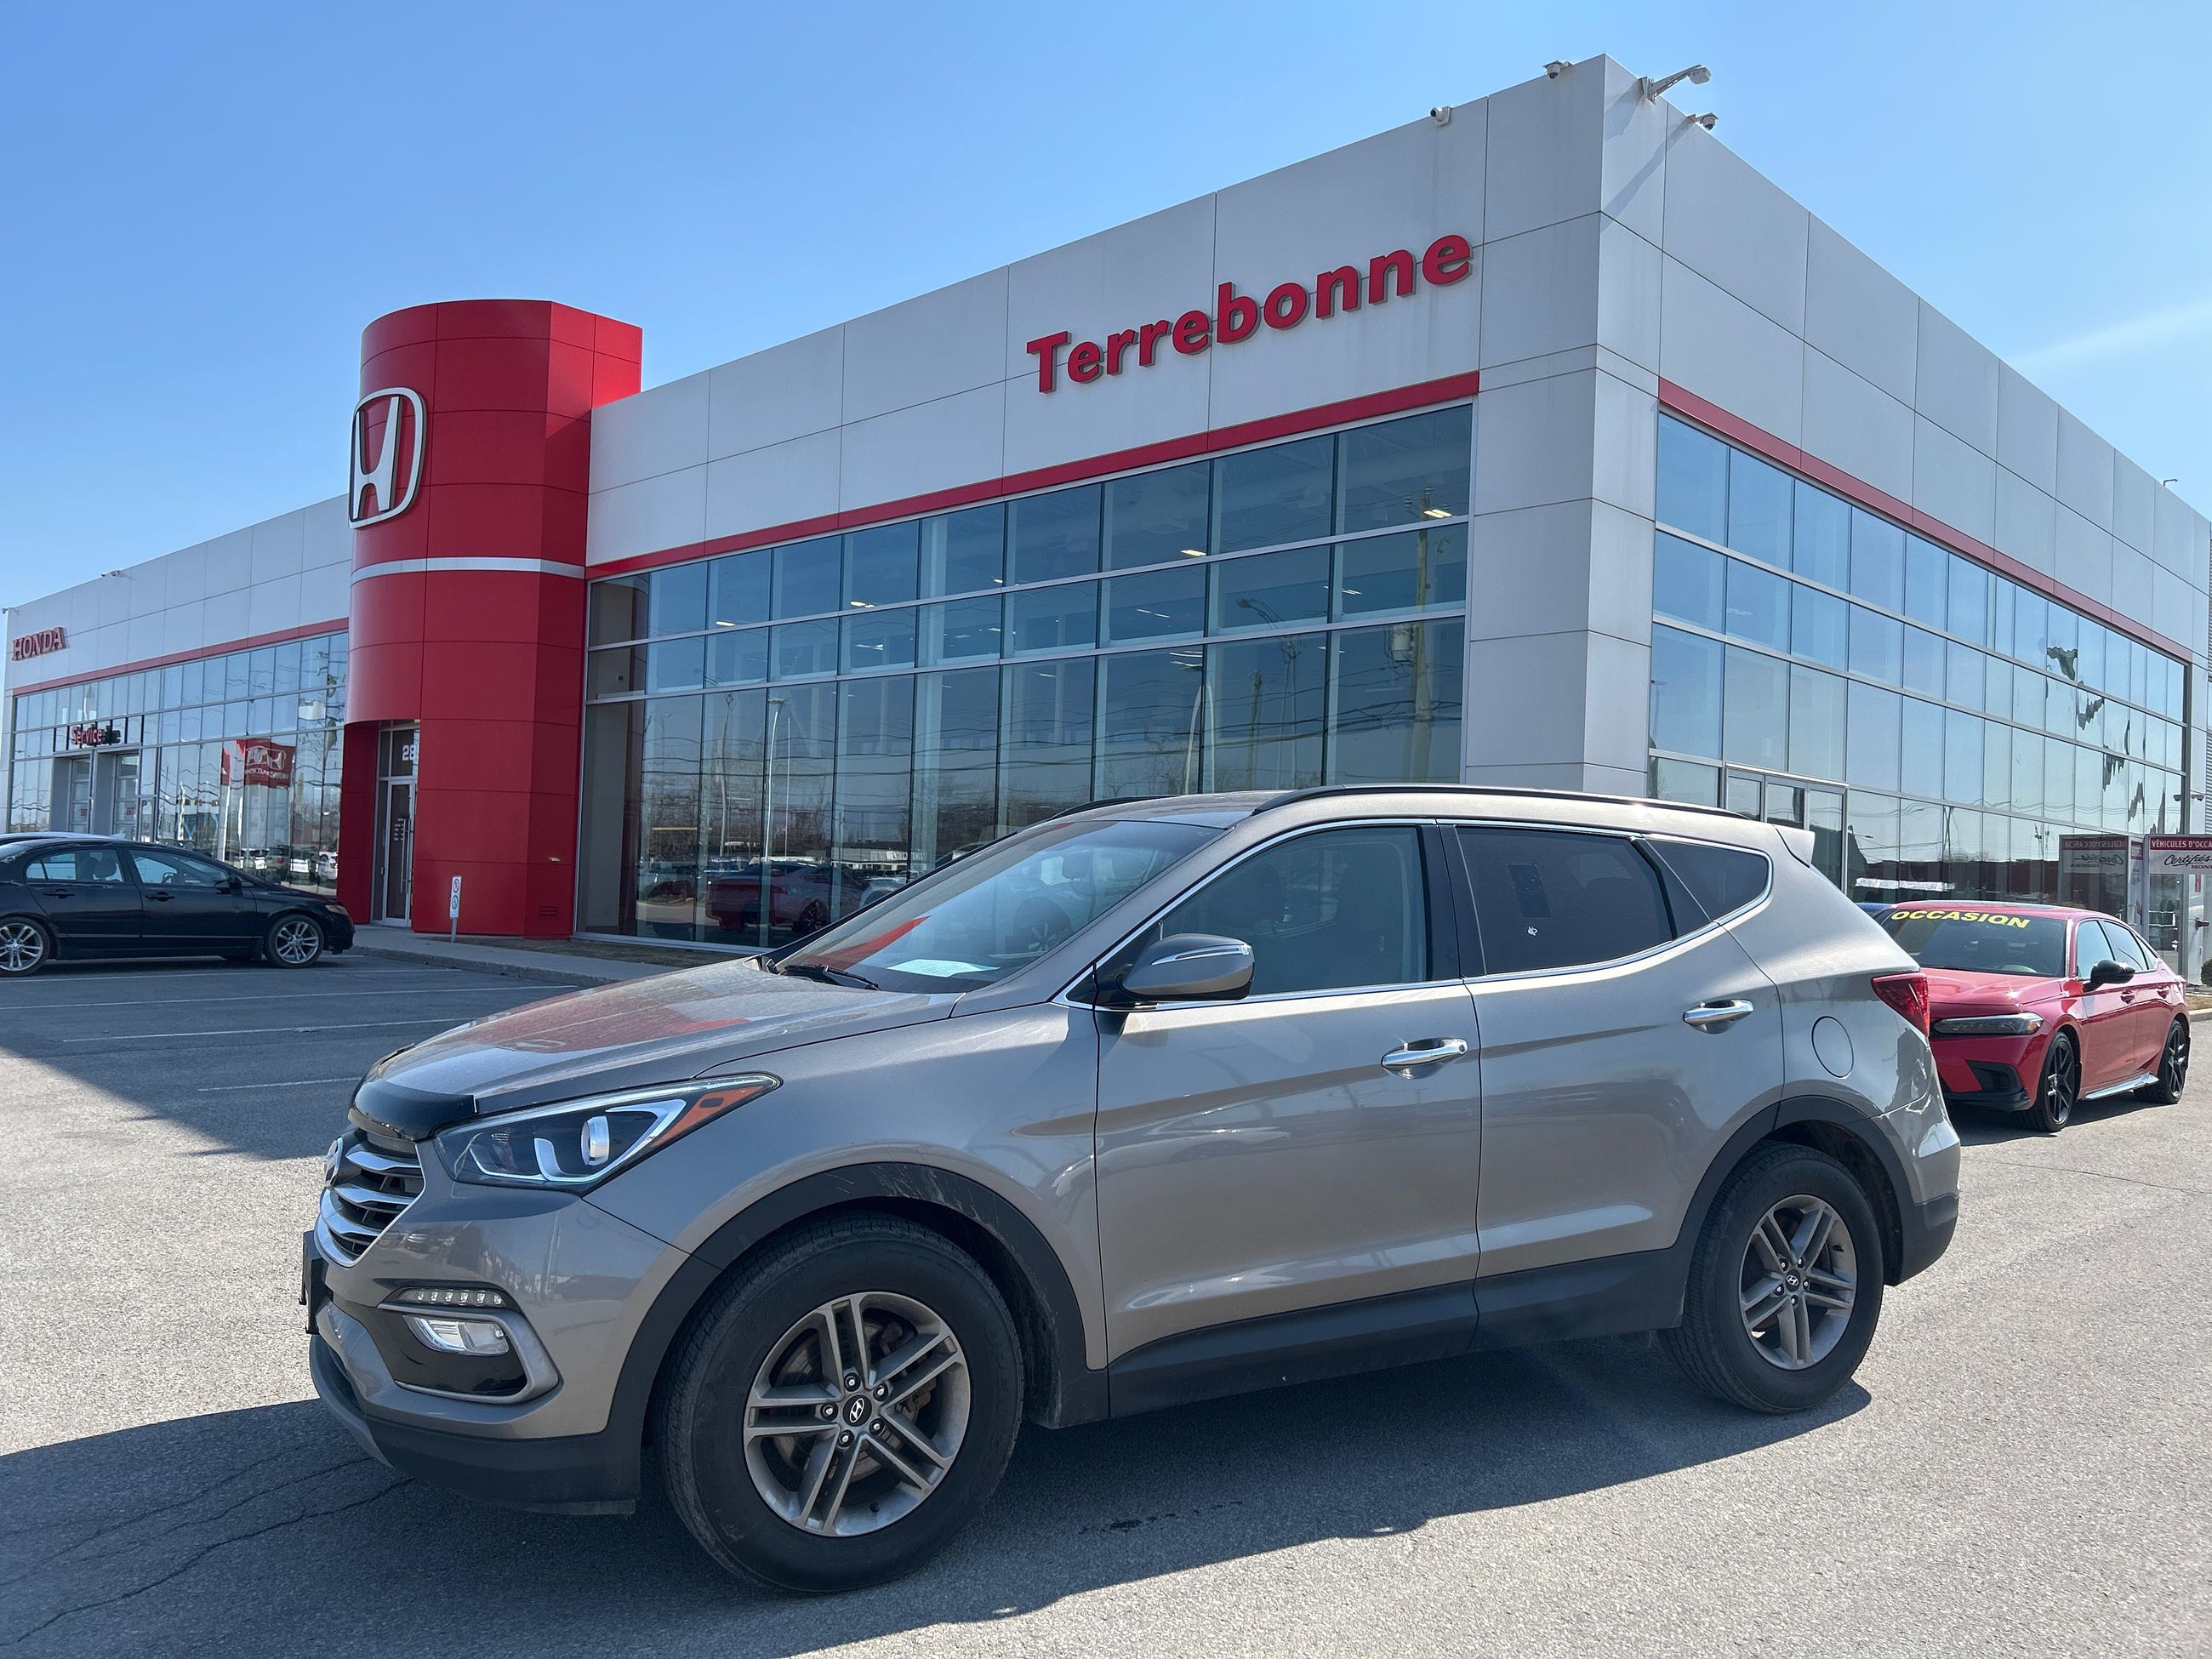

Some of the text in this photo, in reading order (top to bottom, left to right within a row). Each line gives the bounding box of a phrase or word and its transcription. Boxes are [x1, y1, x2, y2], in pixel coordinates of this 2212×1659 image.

[1026, 234, 1472, 393] Terrebonne
[13, 627, 66, 660] HONDA
[2152, 839, 2186, 848] VÉHICULES
[1890, 910, 2031, 929] OCCASION
